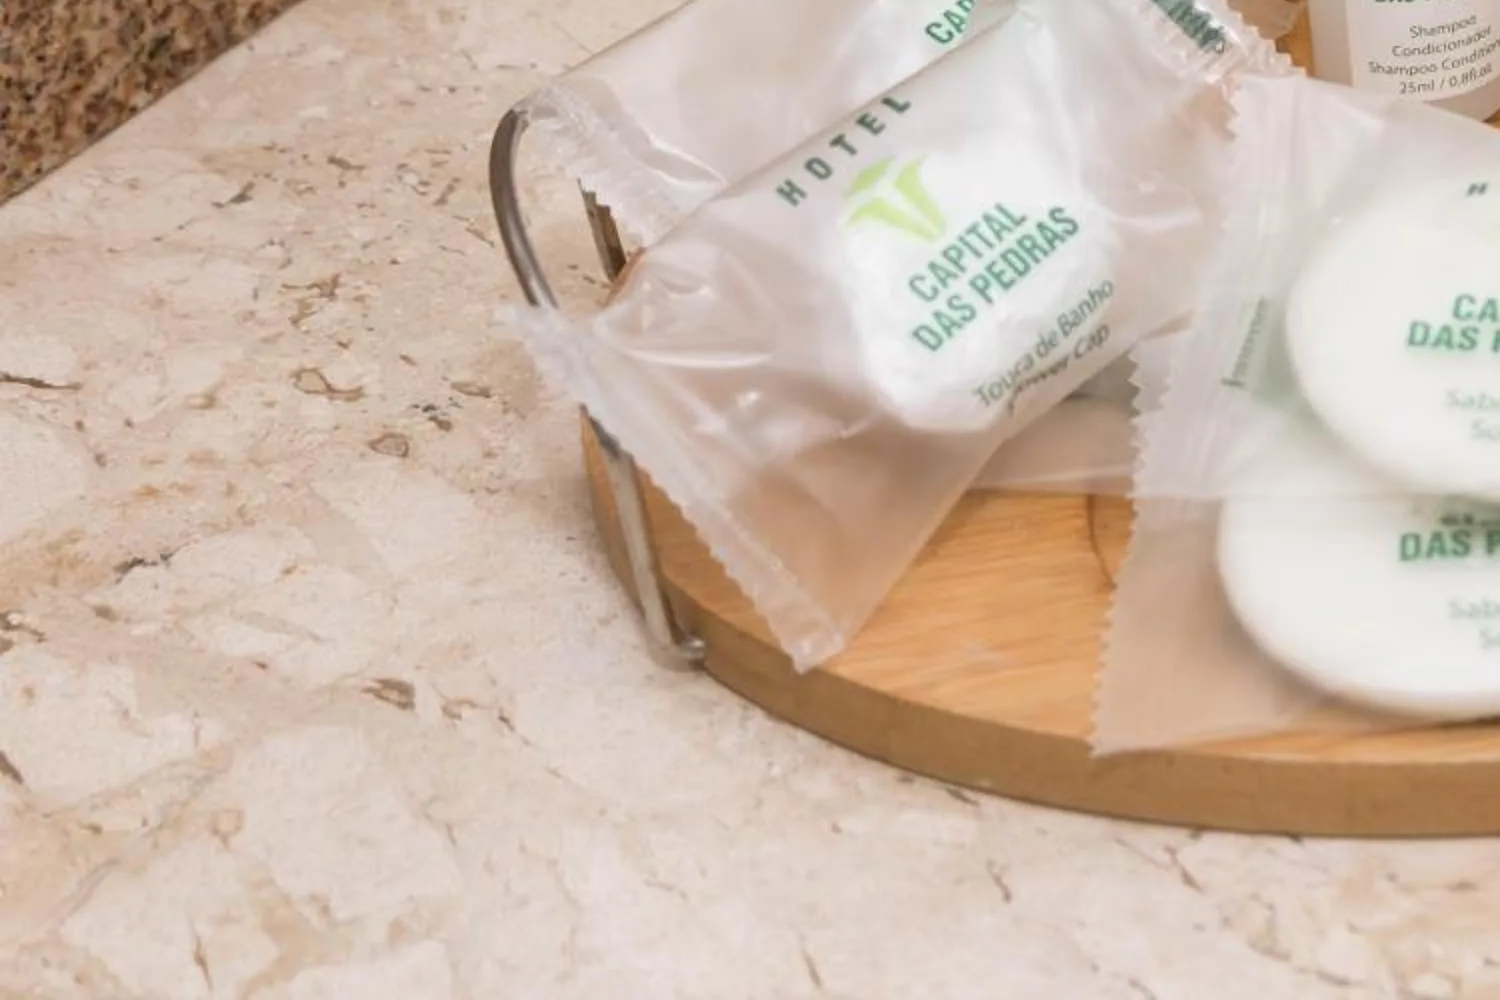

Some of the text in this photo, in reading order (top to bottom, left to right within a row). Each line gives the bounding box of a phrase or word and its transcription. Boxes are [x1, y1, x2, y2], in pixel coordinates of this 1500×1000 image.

[1368, 60, 1437, 77] Shampoo
[1400, 79, 1434, 94] 25ml
[776, 95, 911, 207] HOTEL
[908, 203, 1028, 303] CAPITAL
[911, 206, 1080, 352] DAS PEDRAS
[1035, 329, 1060, 359] de
[1057, 279, 1114, 338] Banho
[1406, 320, 1479, 351] DAS
[1398, 528, 1473, 562] DAS
